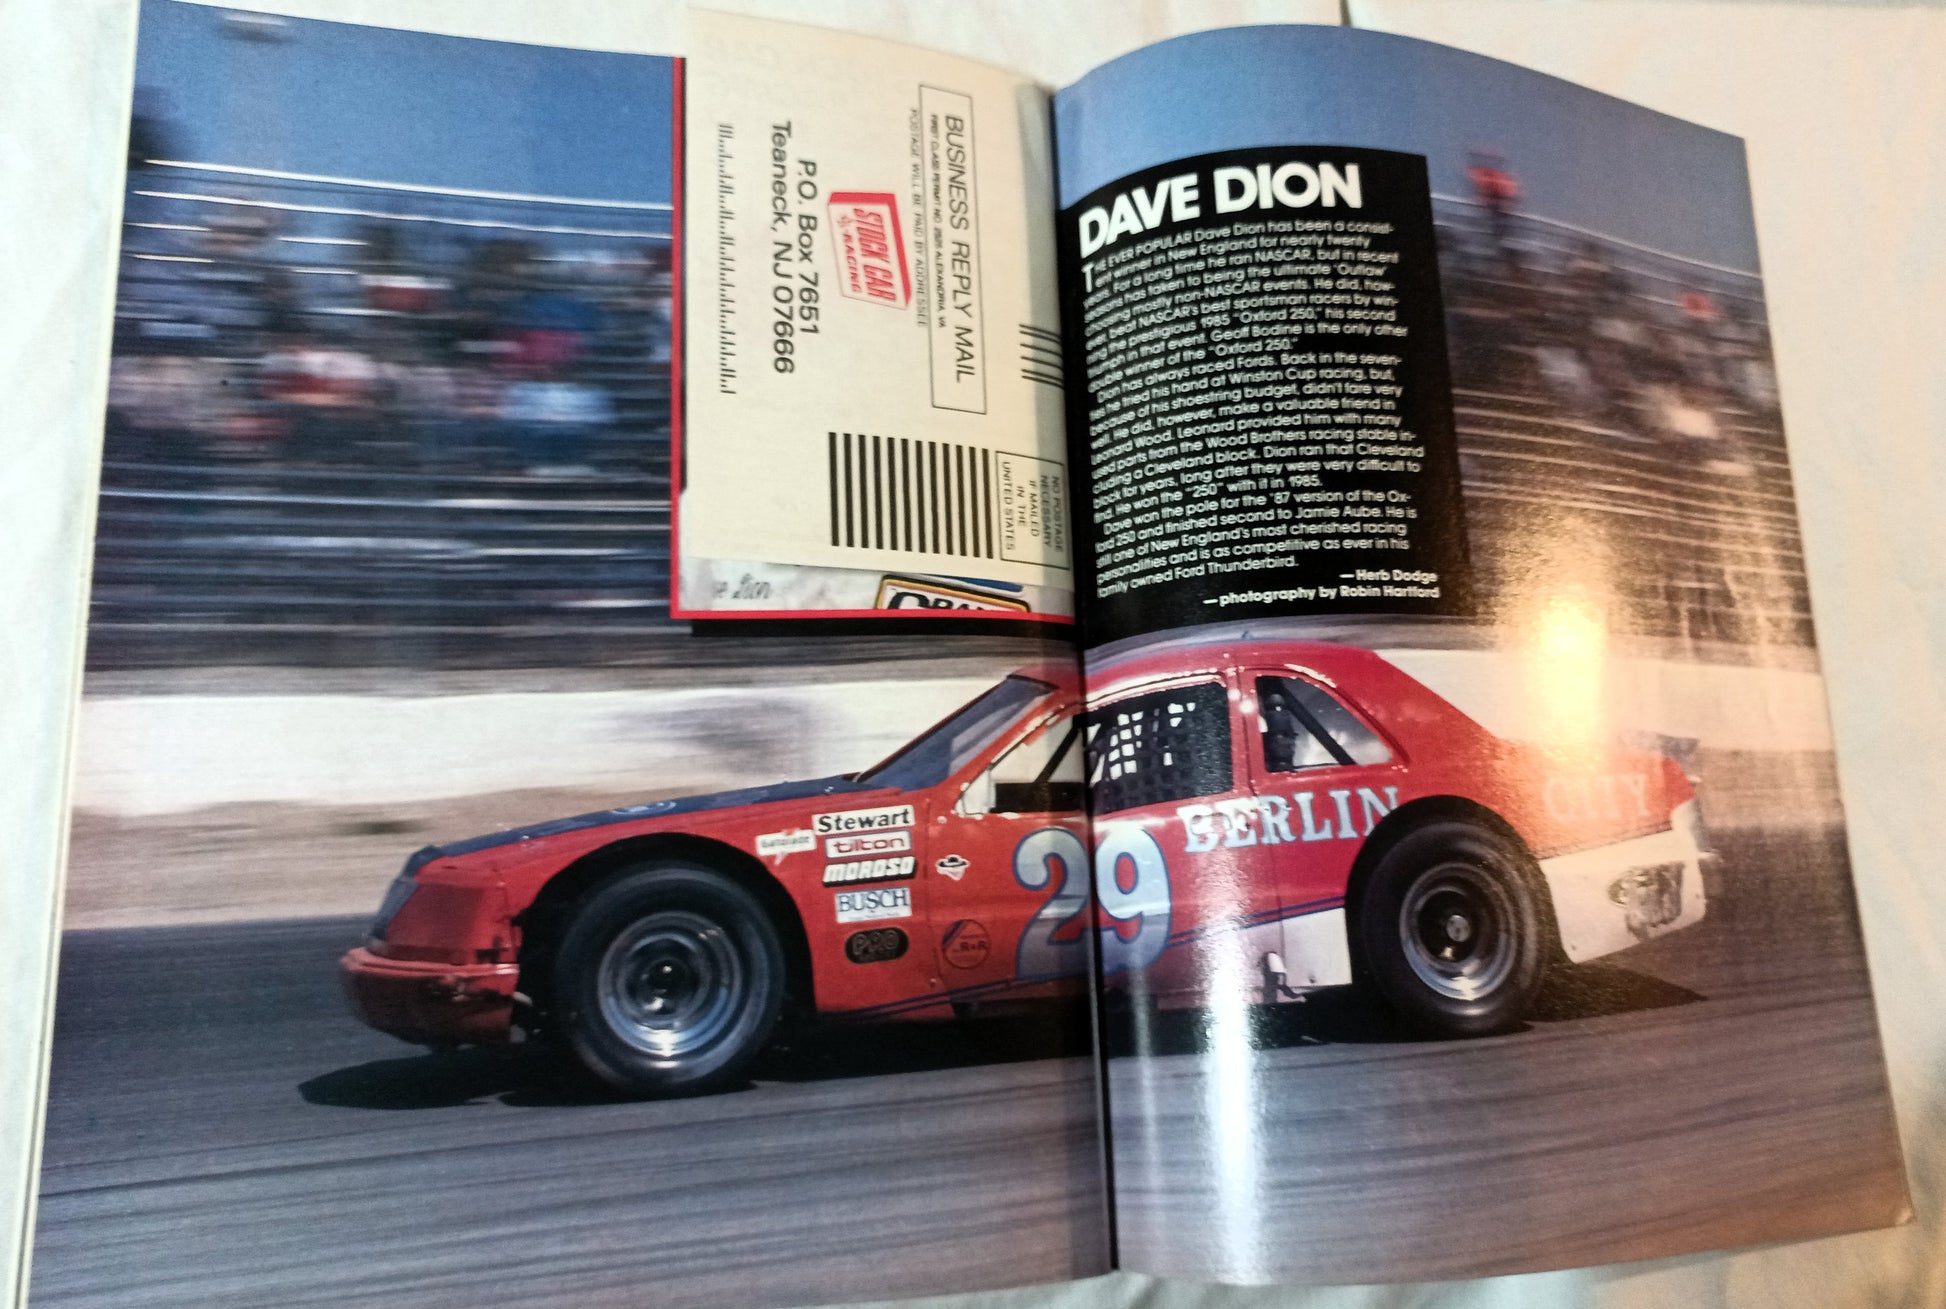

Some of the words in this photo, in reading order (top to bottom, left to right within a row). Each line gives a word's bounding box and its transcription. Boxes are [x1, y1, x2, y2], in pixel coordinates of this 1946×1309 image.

[908, 109, 920, 158] POSTAGE
[770, 121, 793, 232] Teaneck,
[797, 159, 818, 204] P.O.
[911, 163, 921, 187] WILL
[945, 115, 969, 230] BUSINESS
[913, 194, 921, 206] BE
[1079, 173, 1201, 259] DAVE
[1214, 162, 1364, 214] DION
[853, 208, 890, 263] STOCK
[913, 212, 922, 238] PAID
[1194, 228, 1231, 241] Dave
[1233, 222, 1265, 235] Dion
[1268, 221, 1292, 232] has
[1294, 220, 1332, 231] been
[798, 214, 818, 263] Box
[914, 241, 923, 255] BY
[1168, 248, 1198, 260] New
[1200, 236, 1258, 255] England
[1260, 236, 1278, 247] for
[1280, 234, 1325, 248] nearly
[1326, 234, 1371, 248] twenty
[772, 241, 793, 279] NJ
[843, 233, 862, 292] RACING
[1174, 261, 1206, 274] time
[1228, 254, 1252, 265] ran
[1316, 248, 1340, 260] but
[1356, 251, 1399, 262] recent
[1203, 269, 1245, 283] being
[1247, 265, 1271, 277] the
[1273, 263, 1331, 276] ultimate
[863, 264, 897, 301] CAR
[951, 241, 973, 318] REPLY
[1174, 281, 1260, 303] non-NASCAR
[799, 272, 820, 334] 7651
[915, 259, 926, 327] ADDRESSEE
[1200, 299, 1230, 313] best
[1233, 295, 1307, 310] sportsman
[1309, 295, 1352, 304] racers
[773, 285, 795, 374] 07666
[938, 317, 946, 328] VA
[1200, 314, 1230, 328] 1985
[1324, 307, 1344, 319] his
[1346, 310, 1396, 321] second
[1210, 326, 1250, 341] Geoff
[1252, 323, 1302, 336] Bodine
[1317, 322, 1340, 333] the
[1342, 322, 1372, 337] only
[1374, 324, 1408, 336] other
[954, 326, 975, 383] MAIL
[1182, 349, 1206, 361] the
[1192, 358, 1235, 374] raced
[1280, 353, 1317, 365] Back
[1334, 352, 1358, 363] the
[1152, 385, 1170, 397] his
[1172, 377, 1208, 393] hand
[1228, 370, 1283, 383] Winston
[1285, 368, 1317, 381] Cup
[1151, 400, 1170, 413] his
[1171, 389, 1241, 409] shoestring
[1302, 382, 1342, 394] didn't
[1344, 382, 1372, 393] fare
[1373, 385, 1403, 397] very
[1218, 402, 1260, 415] make
[1275, 397, 1340, 410] valuable
[1341, 397, 1381, 409] friend
[1178, 419, 1235, 437] Leonard
[1237, 413, 1302, 432] provided
[1304, 413, 1332, 424] him
[1333, 412, 1361, 423] with
[1363, 415, 1402, 427] many
[1180, 441, 1203, 453] the
[1206, 433, 1248, 448] Wood
[1250, 430, 1306, 443] Brothers
[1308, 428, 1354, 442] racing
[1356, 428, 1398, 440] stable
[1144, 453, 1213, 476] Cleveland
[1215, 447, 1260, 462] block.
[1263, 445, 1297, 457] Dion
[1298, 446, 1323, 455] ran
[1326, 443, 1354, 454] that
[1356, 443, 1424, 457] Cleveland
[1180, 471, 1212, 484] long
[1214, 466, 1248, 478] after
[1250, 462, 1282, 475] they
[1284, 461, 1320, 471] were
[1323, 461, 1354, 473] very
[1356, 459, 1404, 471] difficult
[1406, 461, 1420, 472] to
[1002, 461, 1014, 505] UNITED
[1017, 486, 1025, 498] IN
[1029, 480, 1037, 488] IF
[1160, 490, 1183, 503] the
[1226, 478, 1256, 492] with
[1259, 477, 1268, 489] it
[1270, 476, 1284, 487] in
[1018, 505, 1027, 527] THE
[1030, 493, 1039, 537] MAILED
[1161, 506, 1184, 518] the
[1186, 500, 1218, 517] pole
[1220, 497, 1240, 508] for
[1242, 494, 1266, 506] the
[1293, 490, 1344, 502] version
[1346, 489, 1360, 500] of
[1362, 489, 1385, 501] the
[1005, 508, 1015, 550] STATES
[1165, 514, 1217, 533] finished
[1220, 509, 1274, 524] second
[1277, 508, 1292, 519] to
[1295, 506, 1340, 518] Jamie
[1385, 506, 1404, 518] He
[1406, 507, 1417, 518] is
[1150, 539, 1180, 551] New
[1181, 527, 1250, 545] England's
[1252, 523, 1287, 537] most
[1290, 521, 1361, 534] cherished
[1362, 522, 1408, 536] racing
[1168, 549, 1197, 564] and
[1200, 548, 1210, 559] is
[1212, 547, 1230, 557] as
[1232, 539, 1320, 555] competitive
[1322, 540, 1340, 549] as
[1342, 540, 1373, 549] ever
[1375, 538, 1388, 549] in
[1390, 538, 1409, 549] his
[1174, 564, 1205, 579] Ford
[1208, 555, 1299, 574] Thunderbird.
[1392, 569, 1439, 584] Dodge
[1318, 586, 1337, 599] by
[1340, 585, 1381, 597] Robin
[1382, 585, 1440, 598] Hartford
[818, 808, 910, 833] Stewart
[1177, 786, 1399, 854] BERLIN
[832, 837, 905, 853] tilton
[838, 889, 909, 912] BUSCH
[1012, 826, 1172, 981] 29
